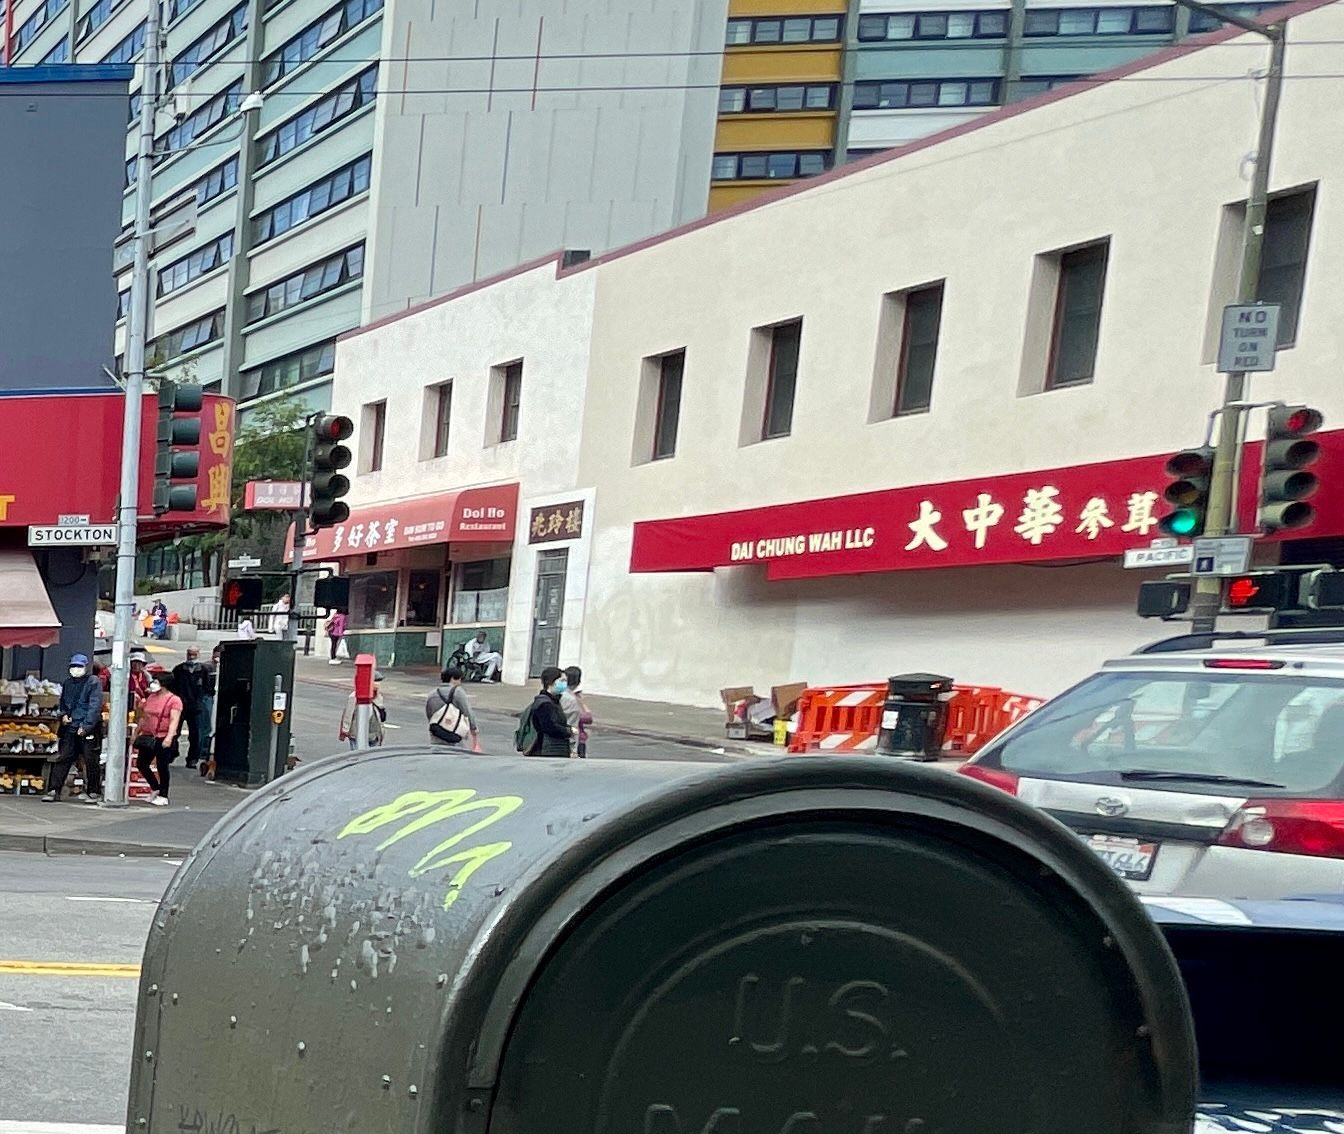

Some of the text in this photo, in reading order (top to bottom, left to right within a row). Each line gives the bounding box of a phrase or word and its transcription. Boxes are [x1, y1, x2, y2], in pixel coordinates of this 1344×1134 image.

[1238, 311, 1267, 323] NO
[1233, 328, 1268, 338] TURN
[1239, 342, 1258, 352] ON
[1234, 356, 1259, 367] RED
[487, 506, 505, 519] Ho
[459, 522, 507, 531] Restaurant
[34, 526, 113, 542] STOCKTON
[332, 518, 399, 553] 多好茶室
[730, 527, 874, 562] DAI CHUNG WAH LLC
[1135, 548, 1189, 563] PACIFIC
[729, 974, 909, 1064] U.S.
